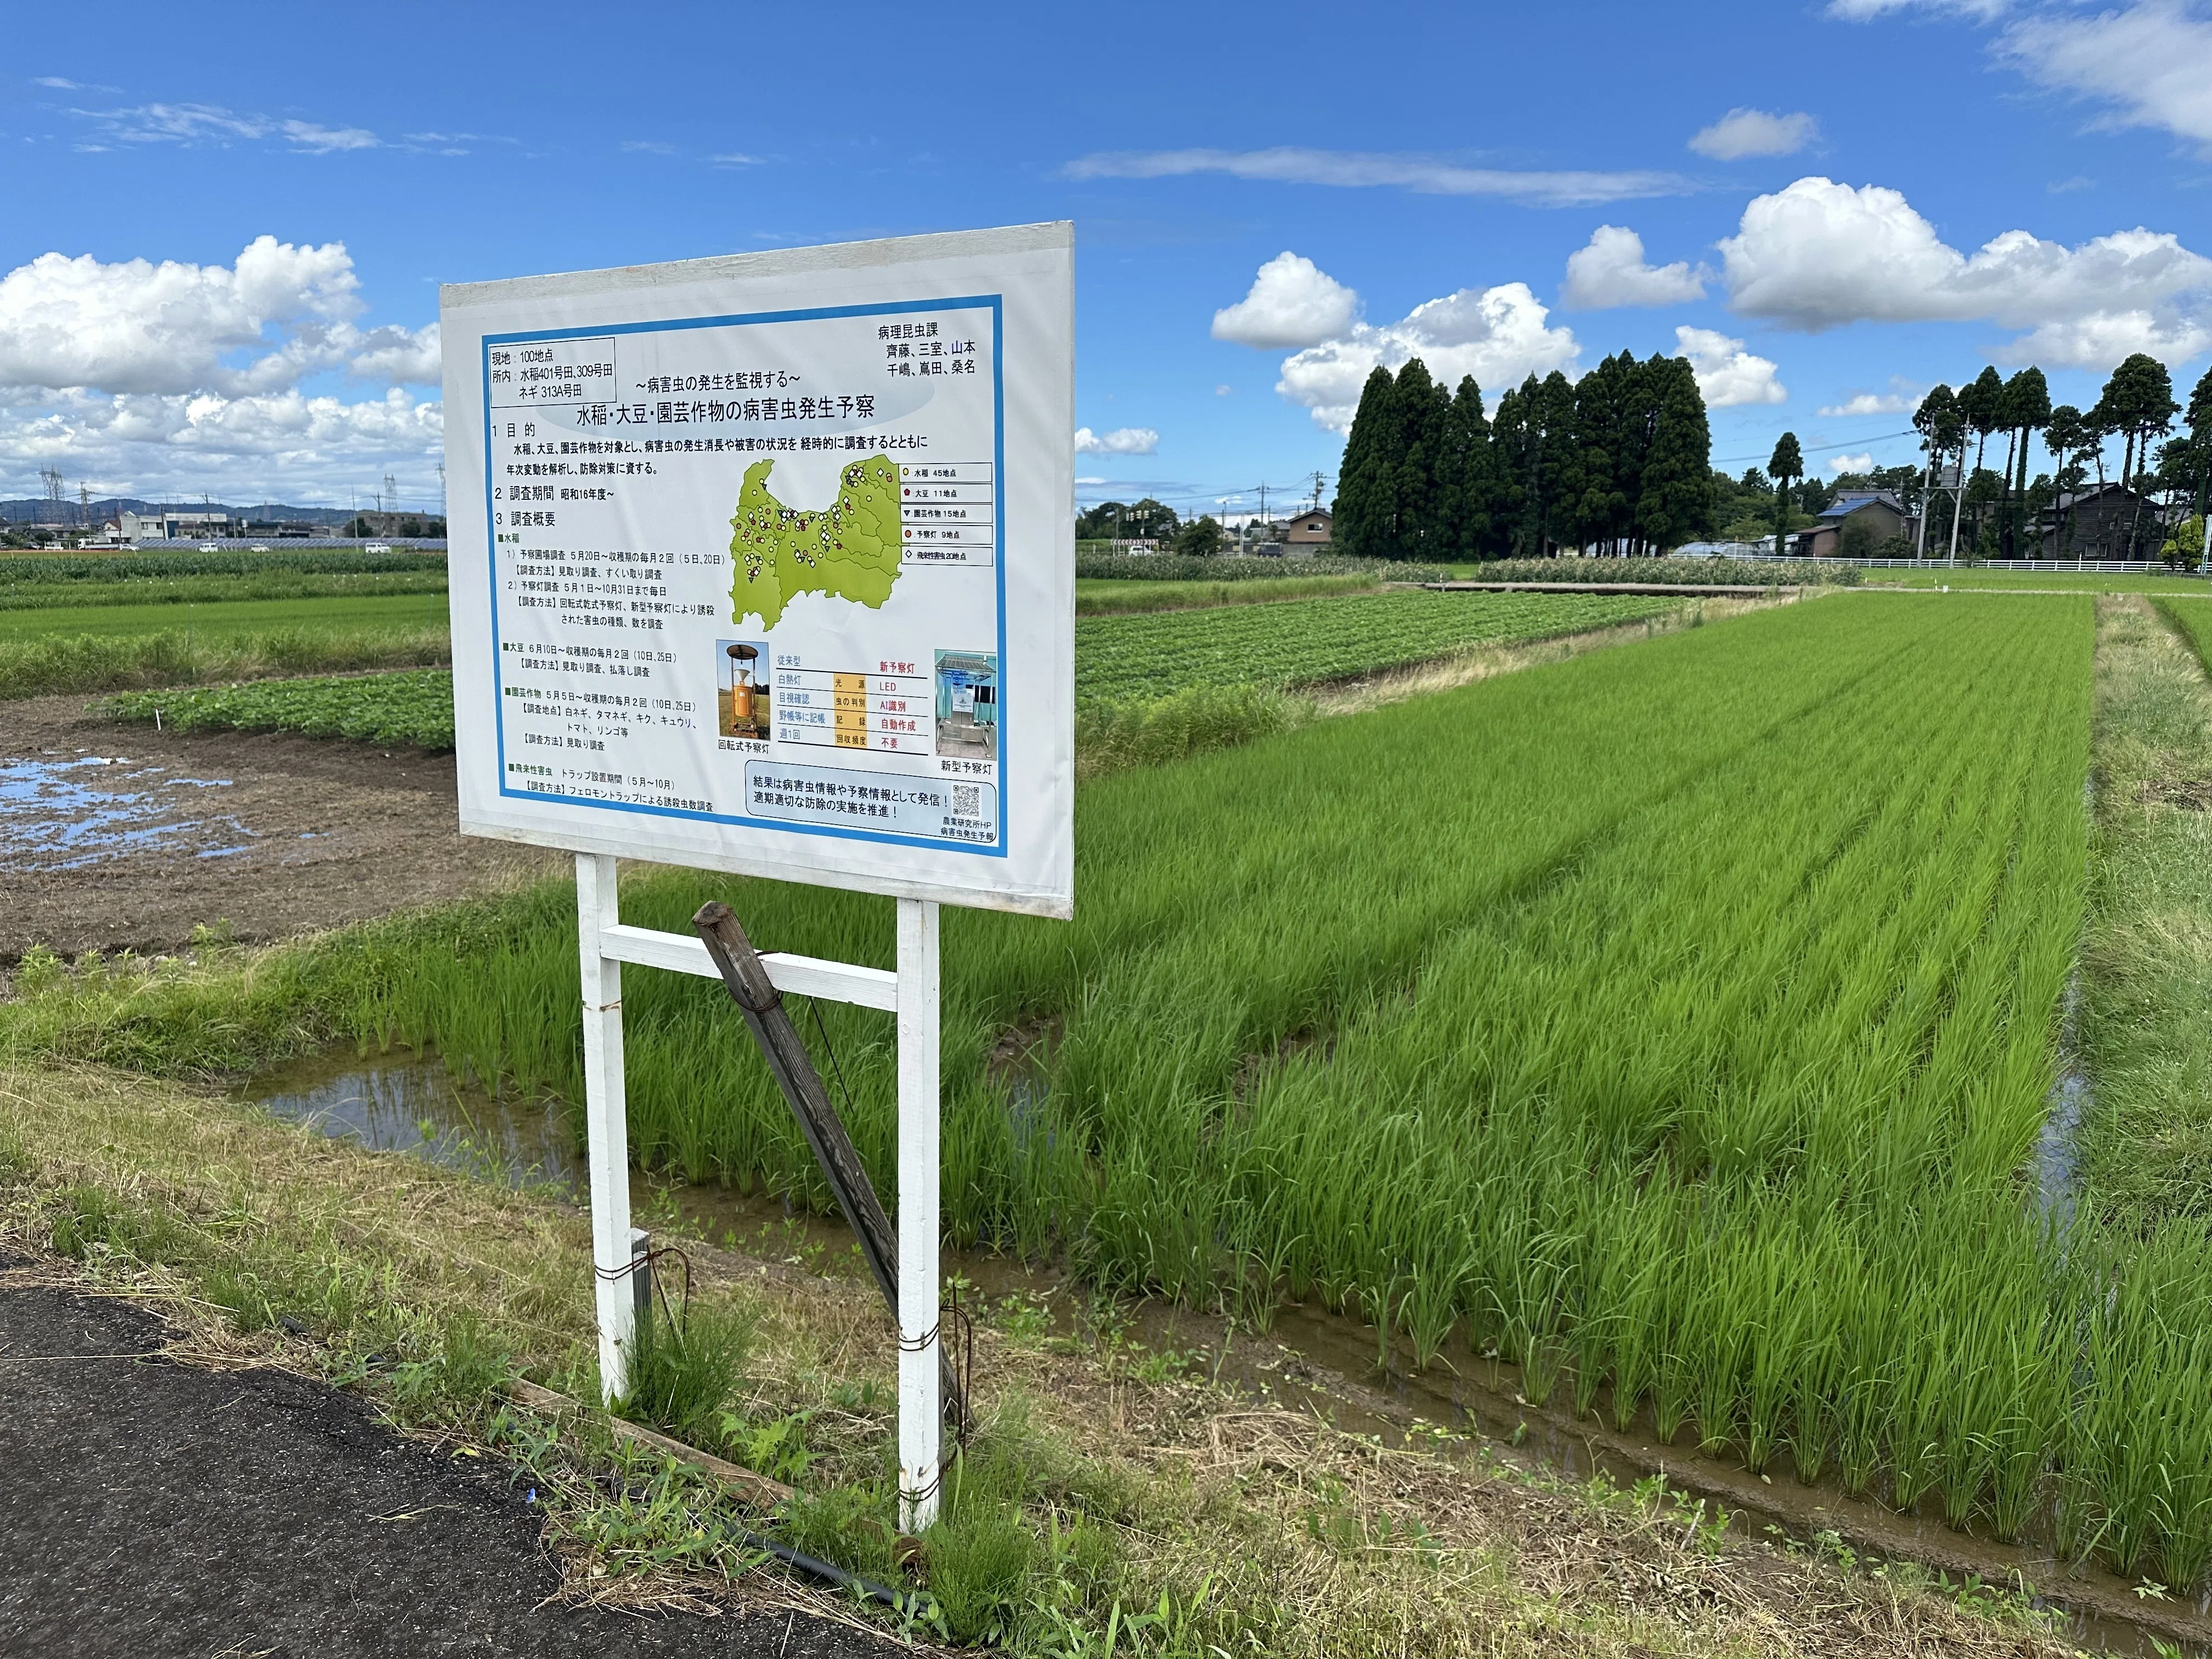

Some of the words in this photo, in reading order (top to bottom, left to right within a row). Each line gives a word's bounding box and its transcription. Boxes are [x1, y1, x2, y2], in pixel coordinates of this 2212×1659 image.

[878, 321, 938, 340] 病理昆虫課
[518, 385, 538, 400] ネギ
[541, 383, 582, 398] 313A号田
[577, 394, 874, 426] 水稲・大豆・園芸作物の病害虫発生予察
[492, 425, 496, 437] 1
[506, 461, 657, 476] 年次変動を解析し、防除対策に資する。
[933, 469, 957, 477] 45地点
[495, 487, 502, 499] 2
[509, 485, 554, 501] 調査期間
[934, 489, 957, 498] 11地点
[495, 512, 503, 525] 3
[510, 511, 556, 527] 調査概要
[943, 509, 967, 518] 15地点
[941, 531, 960, 539] 9地点
[561, 613, 663, 630] された害虫の種類、数を調査
[509, 642, 524, 652] 大豆
[777, 654, 801, 667] 従来型
[879, 660, 915, 674] 新予察灯
[778, 674, 802, 686] 白熱灯
[879, 681, 896, 691] LED
[511, 686, 541, 699] 園芸作物
[779, 692, 810, 705] 目視確認
[880, 701, 906, 712] AI識別
[881, 718, 916, 732] 自動作成
[779, 728, 800, 740] 週1回
[718, 739, 770, 754] 回転式予察灯
[881, 737, 898, 749] 不要
[515, 763, 553, 777] 飛来性害虫
[941, 759, 992, 775] 新型予察灯
[940, 827, 995, 842] 病害虫発生予報
